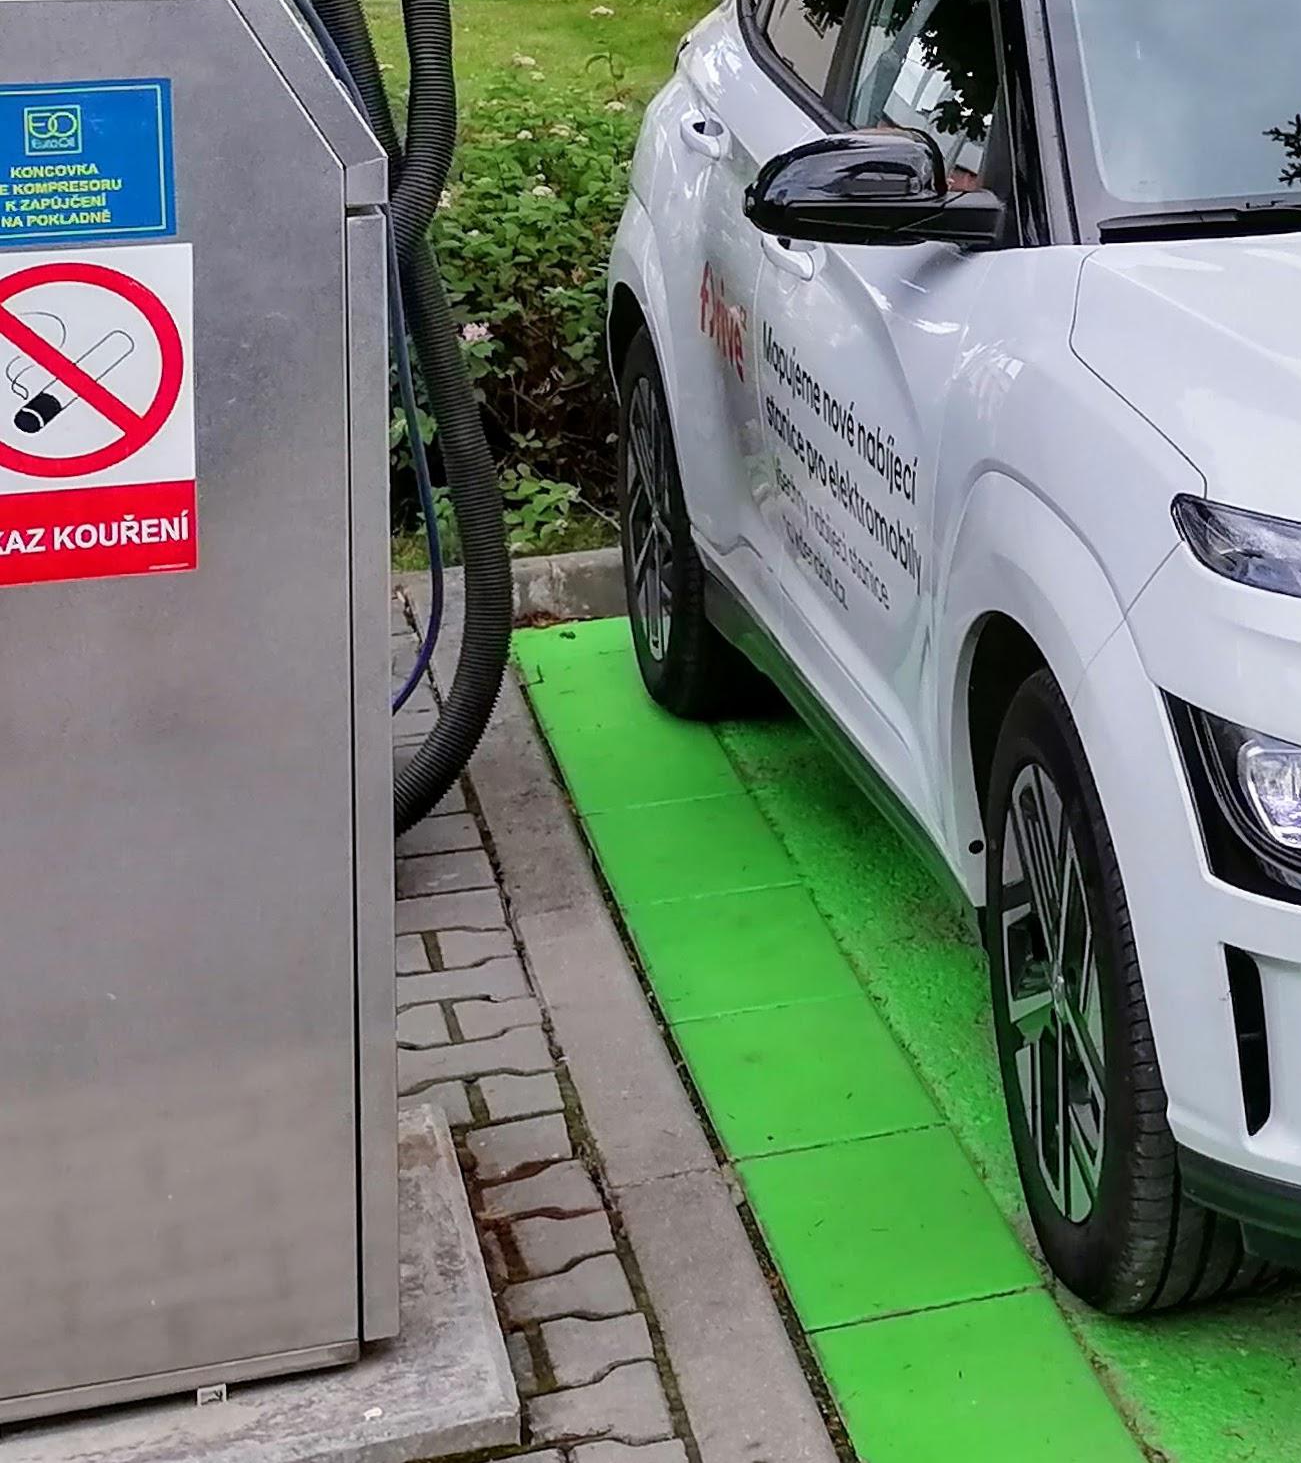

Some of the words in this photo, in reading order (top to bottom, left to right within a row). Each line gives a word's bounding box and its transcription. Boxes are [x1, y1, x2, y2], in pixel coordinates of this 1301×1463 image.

[10, 163, 100, 179] KONCOVKA
[13, 179, 122, 196] KOMPRESORU
[26, 209, 112, 227] POKLADNĚ
[822, 390, 856, 448] nové
[857, 422, 919, 506] nabíjecí
[53, 509, 190, 551] KOUŘENÍ
[805, 439, 828, 487] pro
[828, 459, 922, 597] elektromobily
